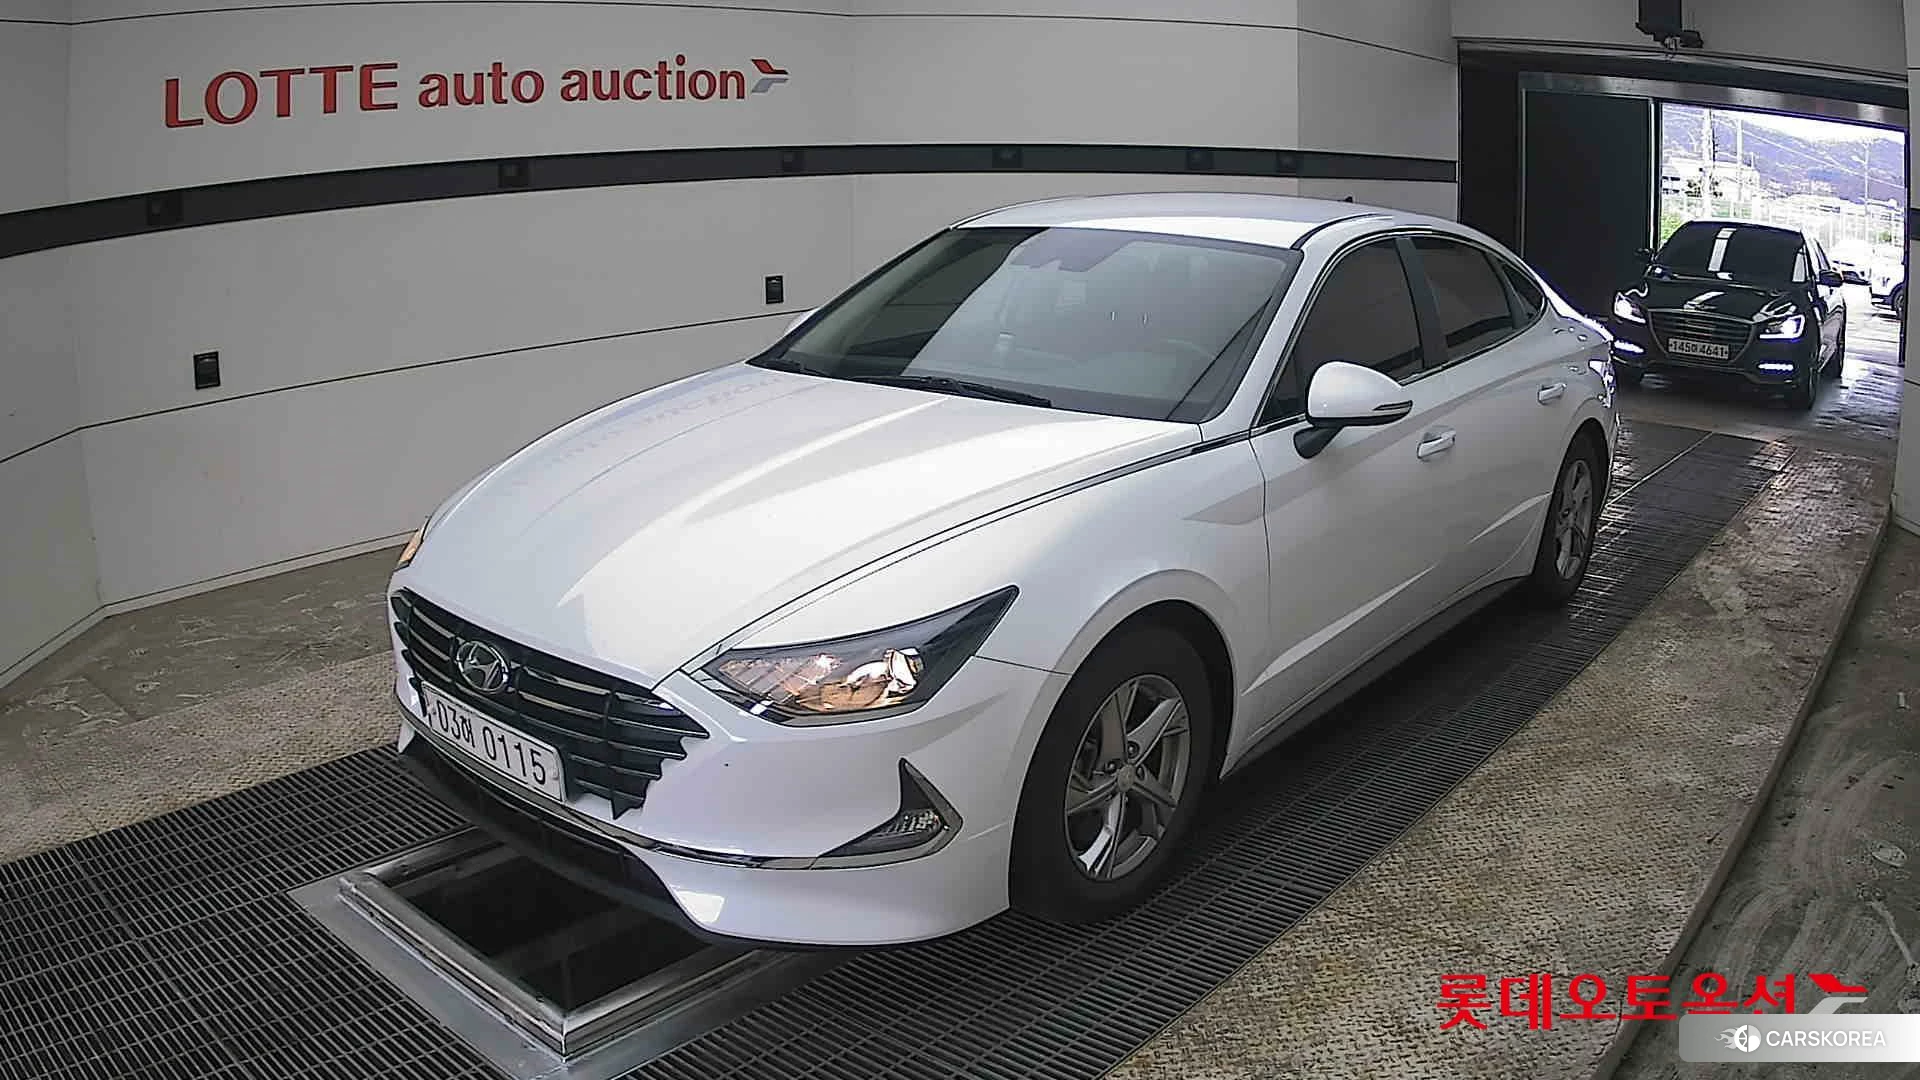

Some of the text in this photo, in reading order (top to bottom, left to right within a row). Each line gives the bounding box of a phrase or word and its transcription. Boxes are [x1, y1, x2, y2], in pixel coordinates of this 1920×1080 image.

[164, 55, 746, 128] LOTTE auto auction
[482, 726, 546, 785] 0115
